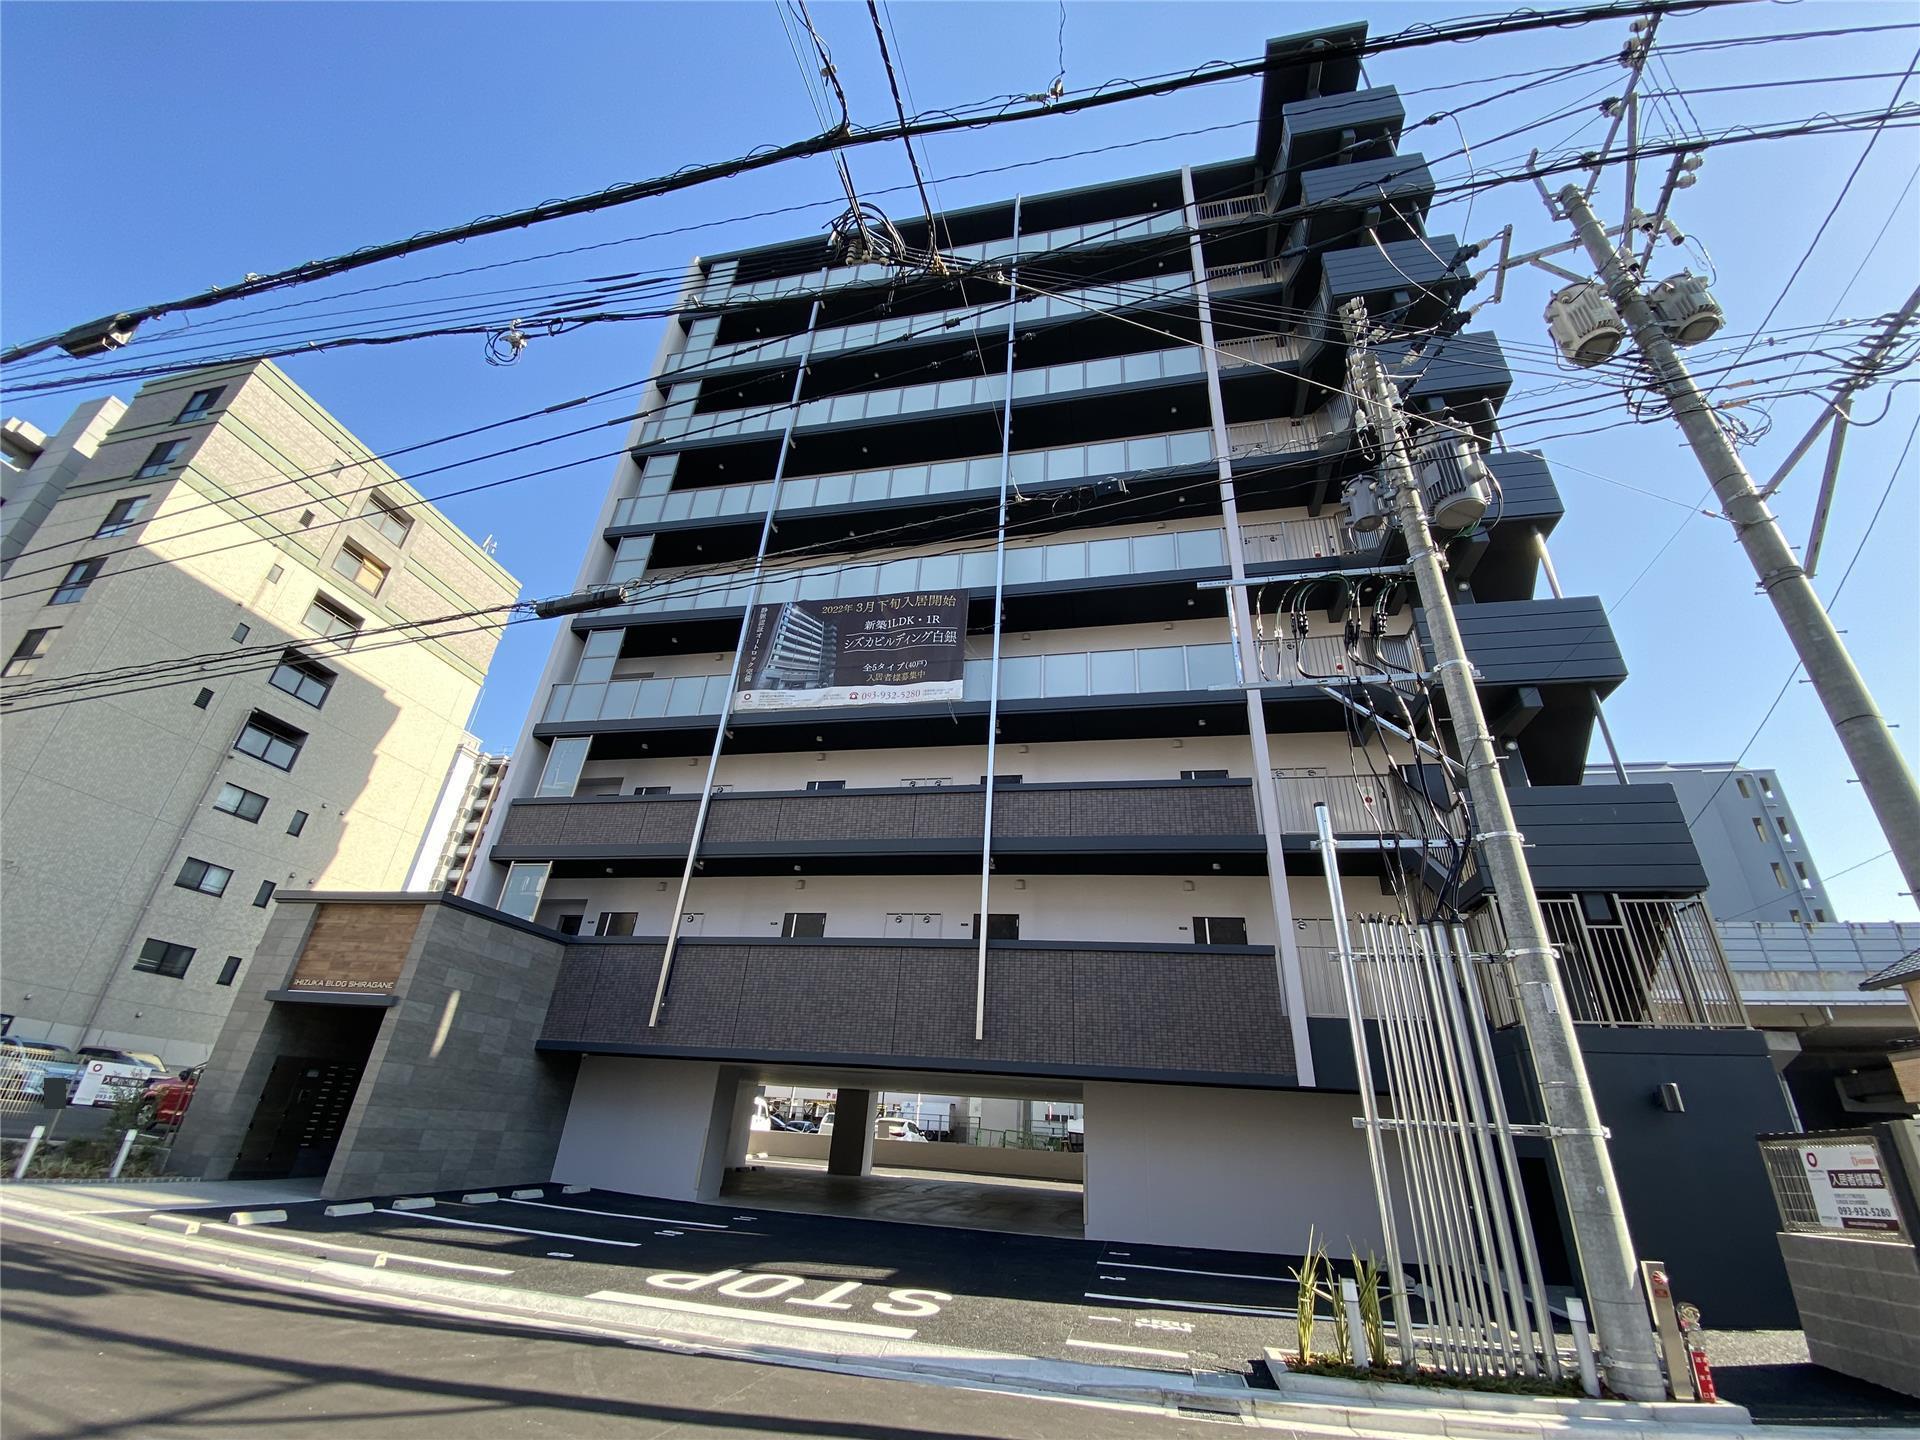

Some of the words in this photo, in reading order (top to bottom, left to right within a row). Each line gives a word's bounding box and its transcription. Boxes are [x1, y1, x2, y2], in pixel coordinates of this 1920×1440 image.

[844, 630, 957, 649] シズカビルディング白銀
[866, 670, 926, 682] 入居者様募集中
[861, 689, 921, 700] 093-932-5280
[325, 979, 348, 987] BLDG
[348, 980, 394, 989] SHIRAGANE
[1838, 1206, 1892, 1217] 093-932-5280
[645, 1268, 953, 1317] STOP
